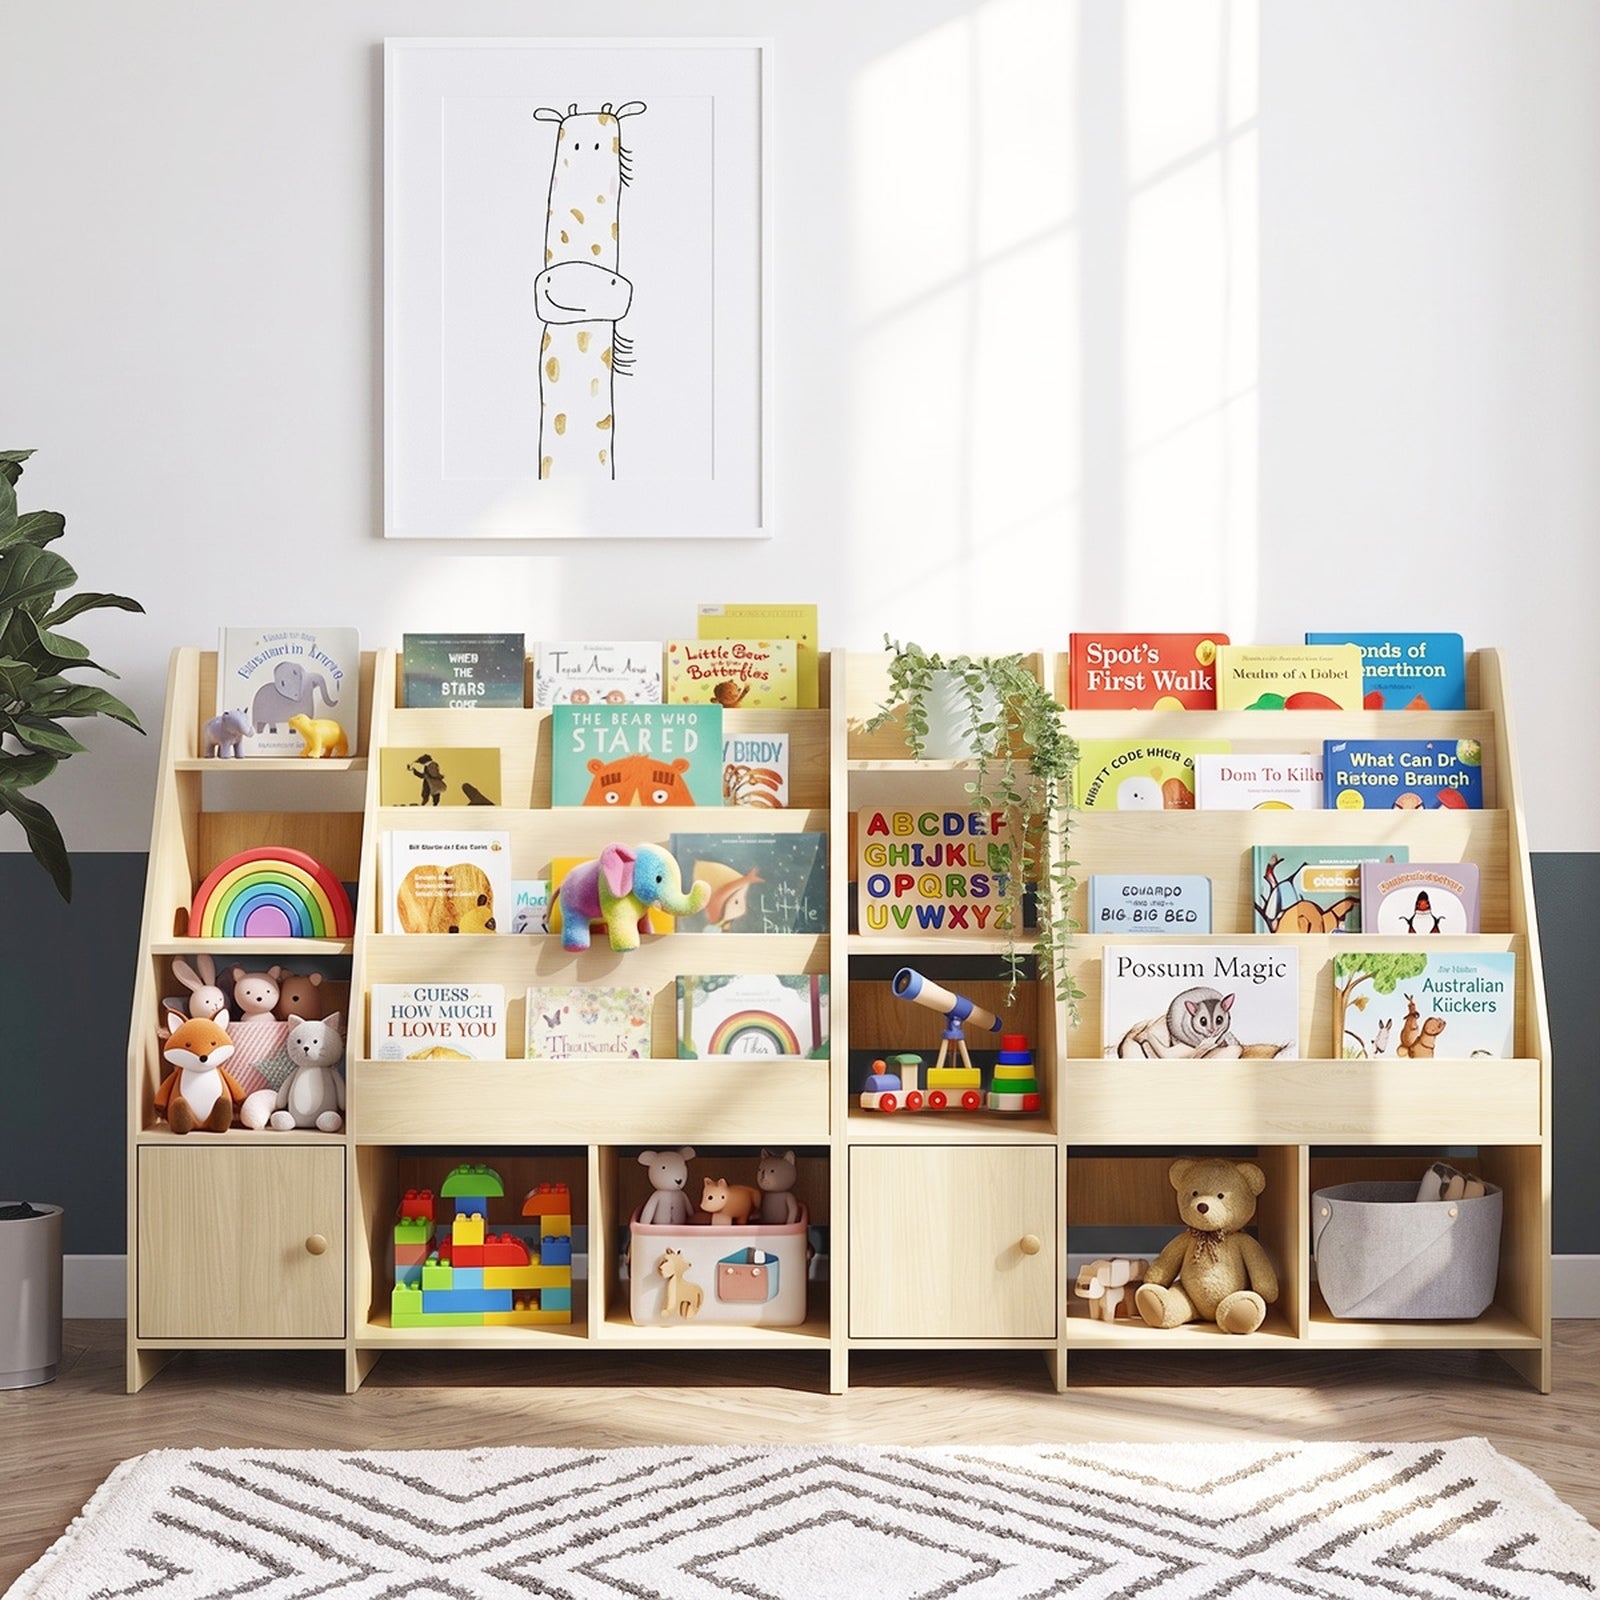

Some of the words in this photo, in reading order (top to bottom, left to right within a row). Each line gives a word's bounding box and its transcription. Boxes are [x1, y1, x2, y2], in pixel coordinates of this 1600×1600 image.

[685, 646, 729, 660] Little
[1087, 643, 1159, 669] Spot's
[1408, 642, 1426, 658] of
[453, 667, 474, 678] THE
[1283, 668, 1297, 680] of
[1087, 670, 1146, 691] First
[1152, 670, 1213, 691] Walk
[441, 682, 485, 696] STARS
[573, 713, 601, 725] THE
[611, 713, 652, 725] BEAR
[661, 713, 698, 725] WHO
[573, 727, 698, 753] STARED
[1111, 749, 1144, 769] CODE
[1350, 753, 1394, 767] What
[1400, 753, 1432, 767] Can
[1438, 754, 1457, 766] Dr
[1220, 767, 1257, 781] Dom
[1261, 767, 1282, 781] To
[1101, 908, 1126, 921] BIG
[1133, 909, 1158, 922] BIG
[1165, 909, 1197, 922] BED
[1117, 956, 1204, 978] Possum
[1214, 956, 1287, 984] Magic
[1422, 977, 1504, 993] Australian
[414, 987, 470, 1002] GUESS
[391, 1005, 433, 1019] HOW
[439, 1004, 493, 1019] MUCH
[387, 1022, 394, 1037] I
[402, 1022, 452, 1038] LOVE
[458, 1022, 497, 1038] YOU
